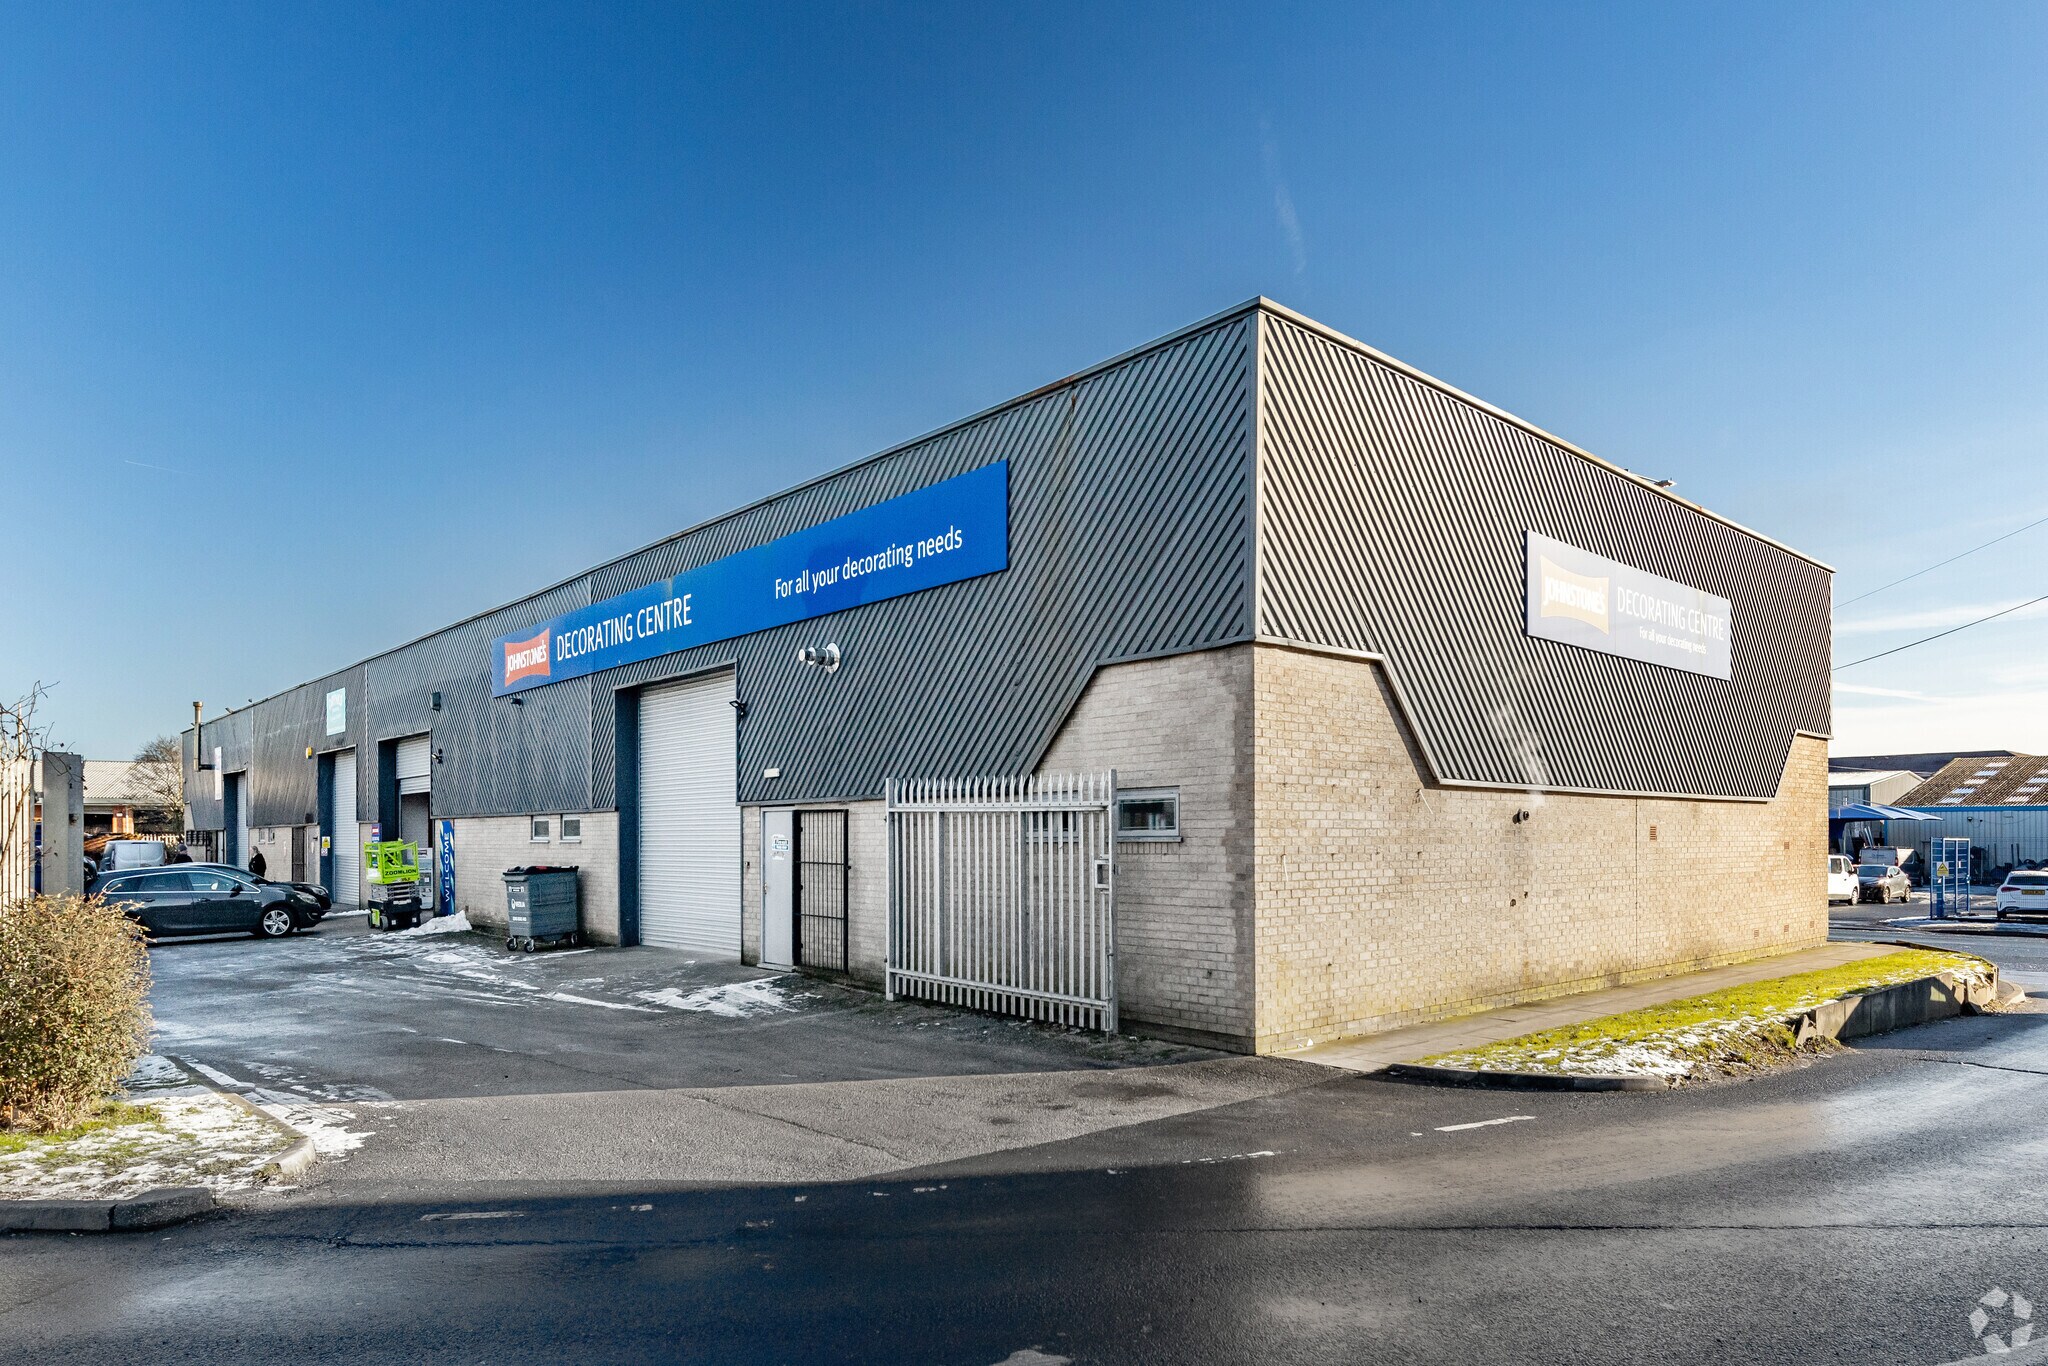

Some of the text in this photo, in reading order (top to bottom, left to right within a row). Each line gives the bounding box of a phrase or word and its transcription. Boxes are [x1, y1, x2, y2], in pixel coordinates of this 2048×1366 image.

[775, 525, 963, 600] For all your decorating needs
[1543, 575, 1606, 616] JOHNSTONE'S
[1617, 586, 1725, 641] DECORATING CENTRE
[557, 593, 692, 661] DECORATING CENTRE
[1639, 626, 1648, 640] For
[1655, 634, 1667, 646] your
[1667, 633, 1692, 654] decorating
[1692, 641, 1707, 655] needs
[506, 639, 547, 678] JOHNSTONE'S
[385, 868, 417, 876] ZOOMLION
[443, 832, 451, 902] WELCOME
